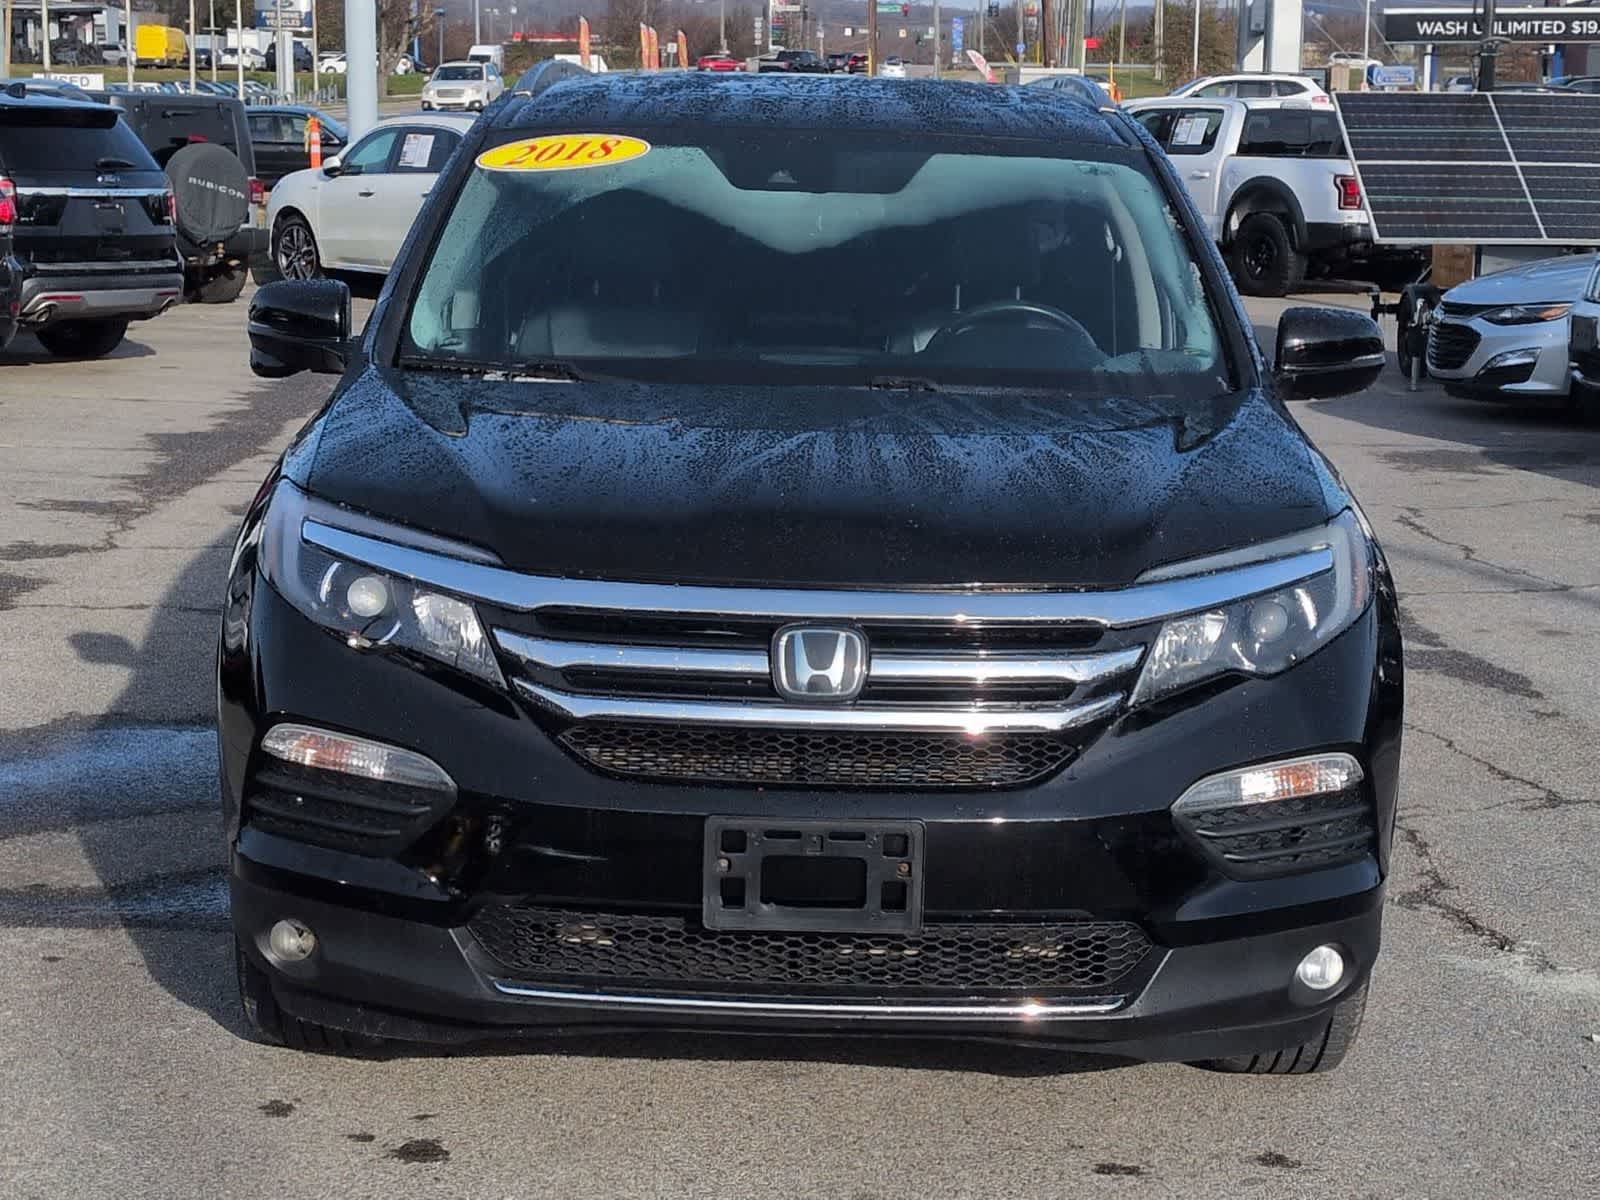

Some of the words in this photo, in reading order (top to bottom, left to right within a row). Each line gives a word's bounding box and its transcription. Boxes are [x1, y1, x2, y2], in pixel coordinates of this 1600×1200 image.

[1416, 20, 1468, 35] WASH
[504, 139, 623, 166] 2018
[188, 176, 246, 199] RUBICON
